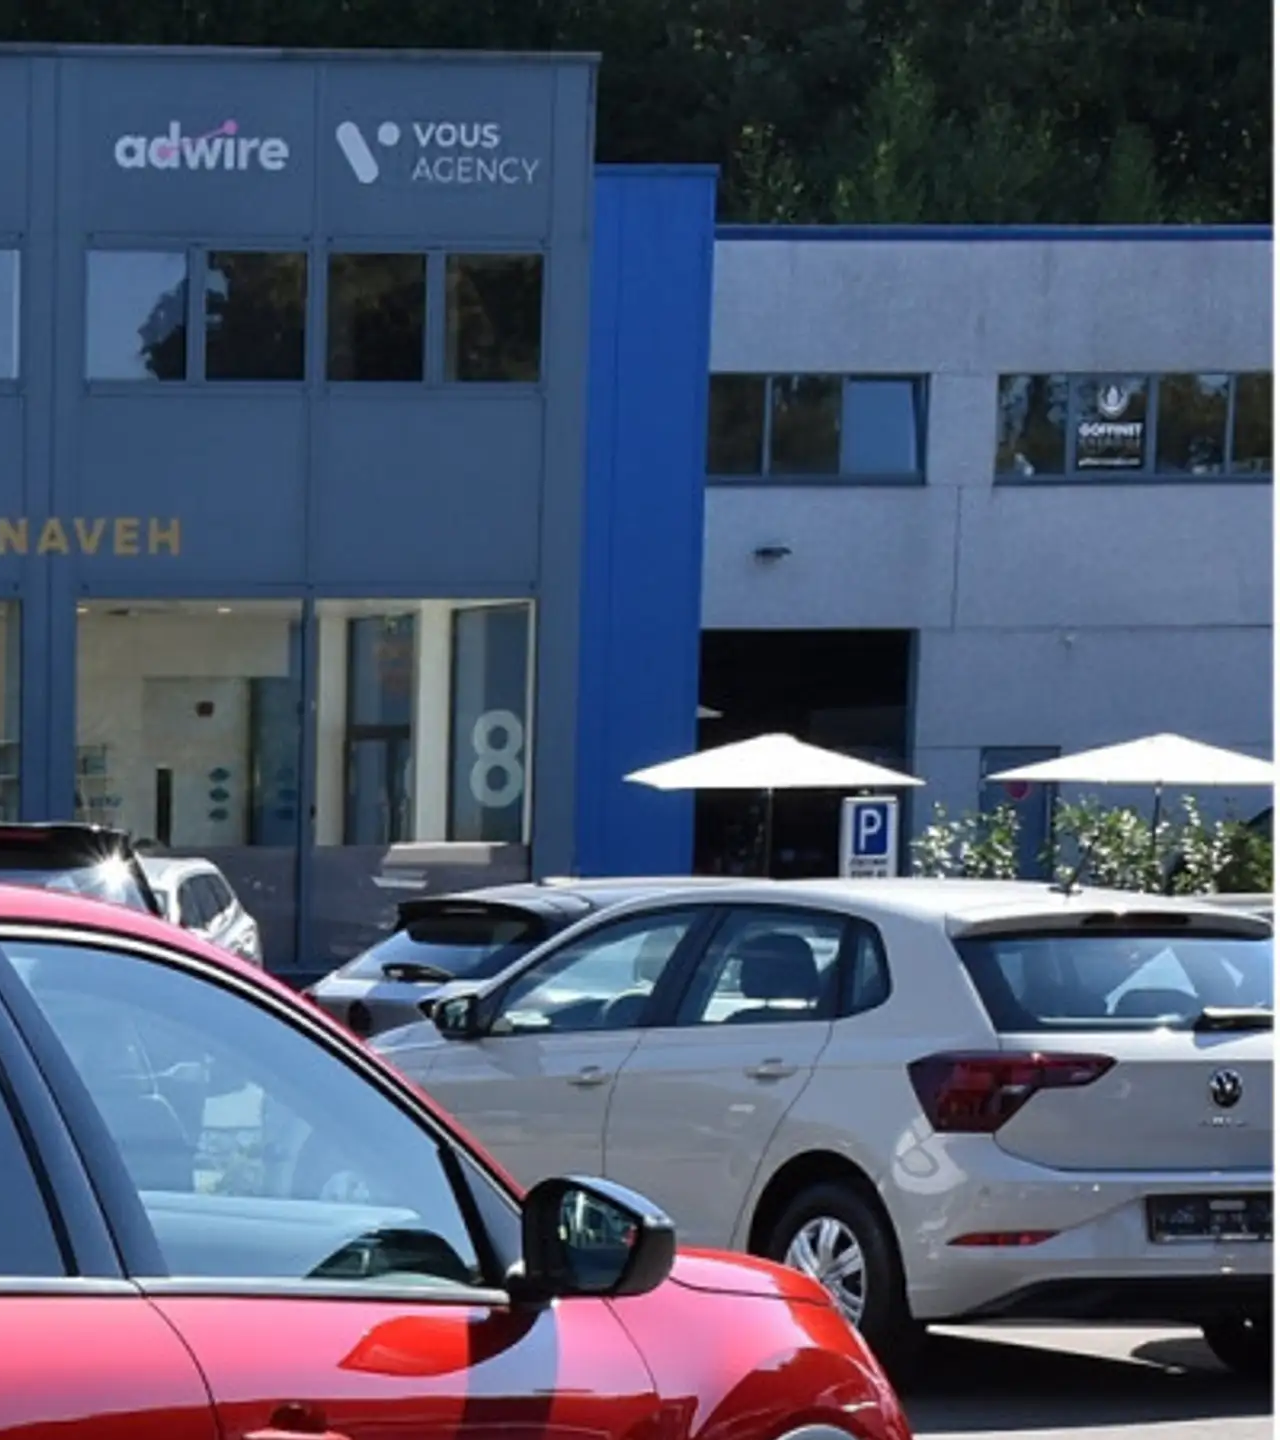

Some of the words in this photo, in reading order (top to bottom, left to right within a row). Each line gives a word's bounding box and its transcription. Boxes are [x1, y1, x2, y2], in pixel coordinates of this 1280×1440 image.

[114, 119, 289, 171] adwire
[412, 122, 500, 149] VOUS
[411, 157, 539, 184] AGENCY
[470, 709, 523, 809] 8
[860, 809, 881, 852] P
